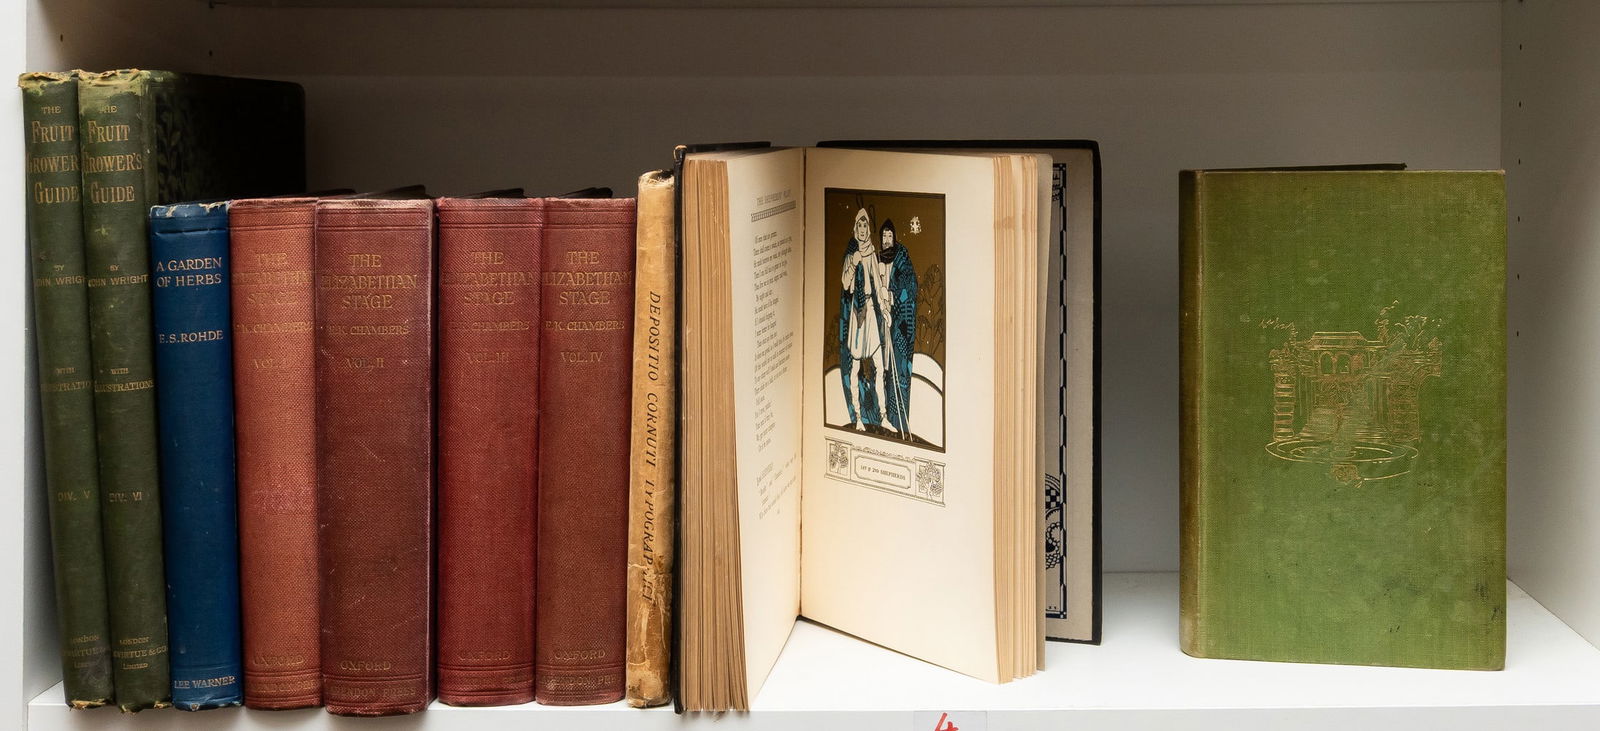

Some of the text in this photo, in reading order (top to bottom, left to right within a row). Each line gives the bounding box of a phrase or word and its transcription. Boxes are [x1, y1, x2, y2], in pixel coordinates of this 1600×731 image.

[32, 120, 75, 143] FRUIT
[87, 120, 131, 143] FRUIT
[34, 181, 79, 204] GUIDE
[90, 181, 136, 204] GUIDE
[156, 257, 222, 272] A GARDEN
[349, 253, 382, 268] THE
[471, 251, 504, 265] THE
[567, 250, 600, 265] THE
[110, 274, 149, 286] WRIGHT
[156, 273, 222, 287] OF HERBS
[341, 294, 393, 309] STAGE
[464, 291, 515, 305] STAGE
[559, 291, 610, 305] STAGE
[566, 320, 625, 331] CHAMBERS
[648, 291, 661, 381] DEPOSITIO
[645, 392, 659, 467] CORNUTI
[132, 491, 142, 501] VI
[554, 649, 606, 660] OXFORD
[340, 660, 392, 671] OXFORD
[174, 676, 235, 689] LEE WARNER
